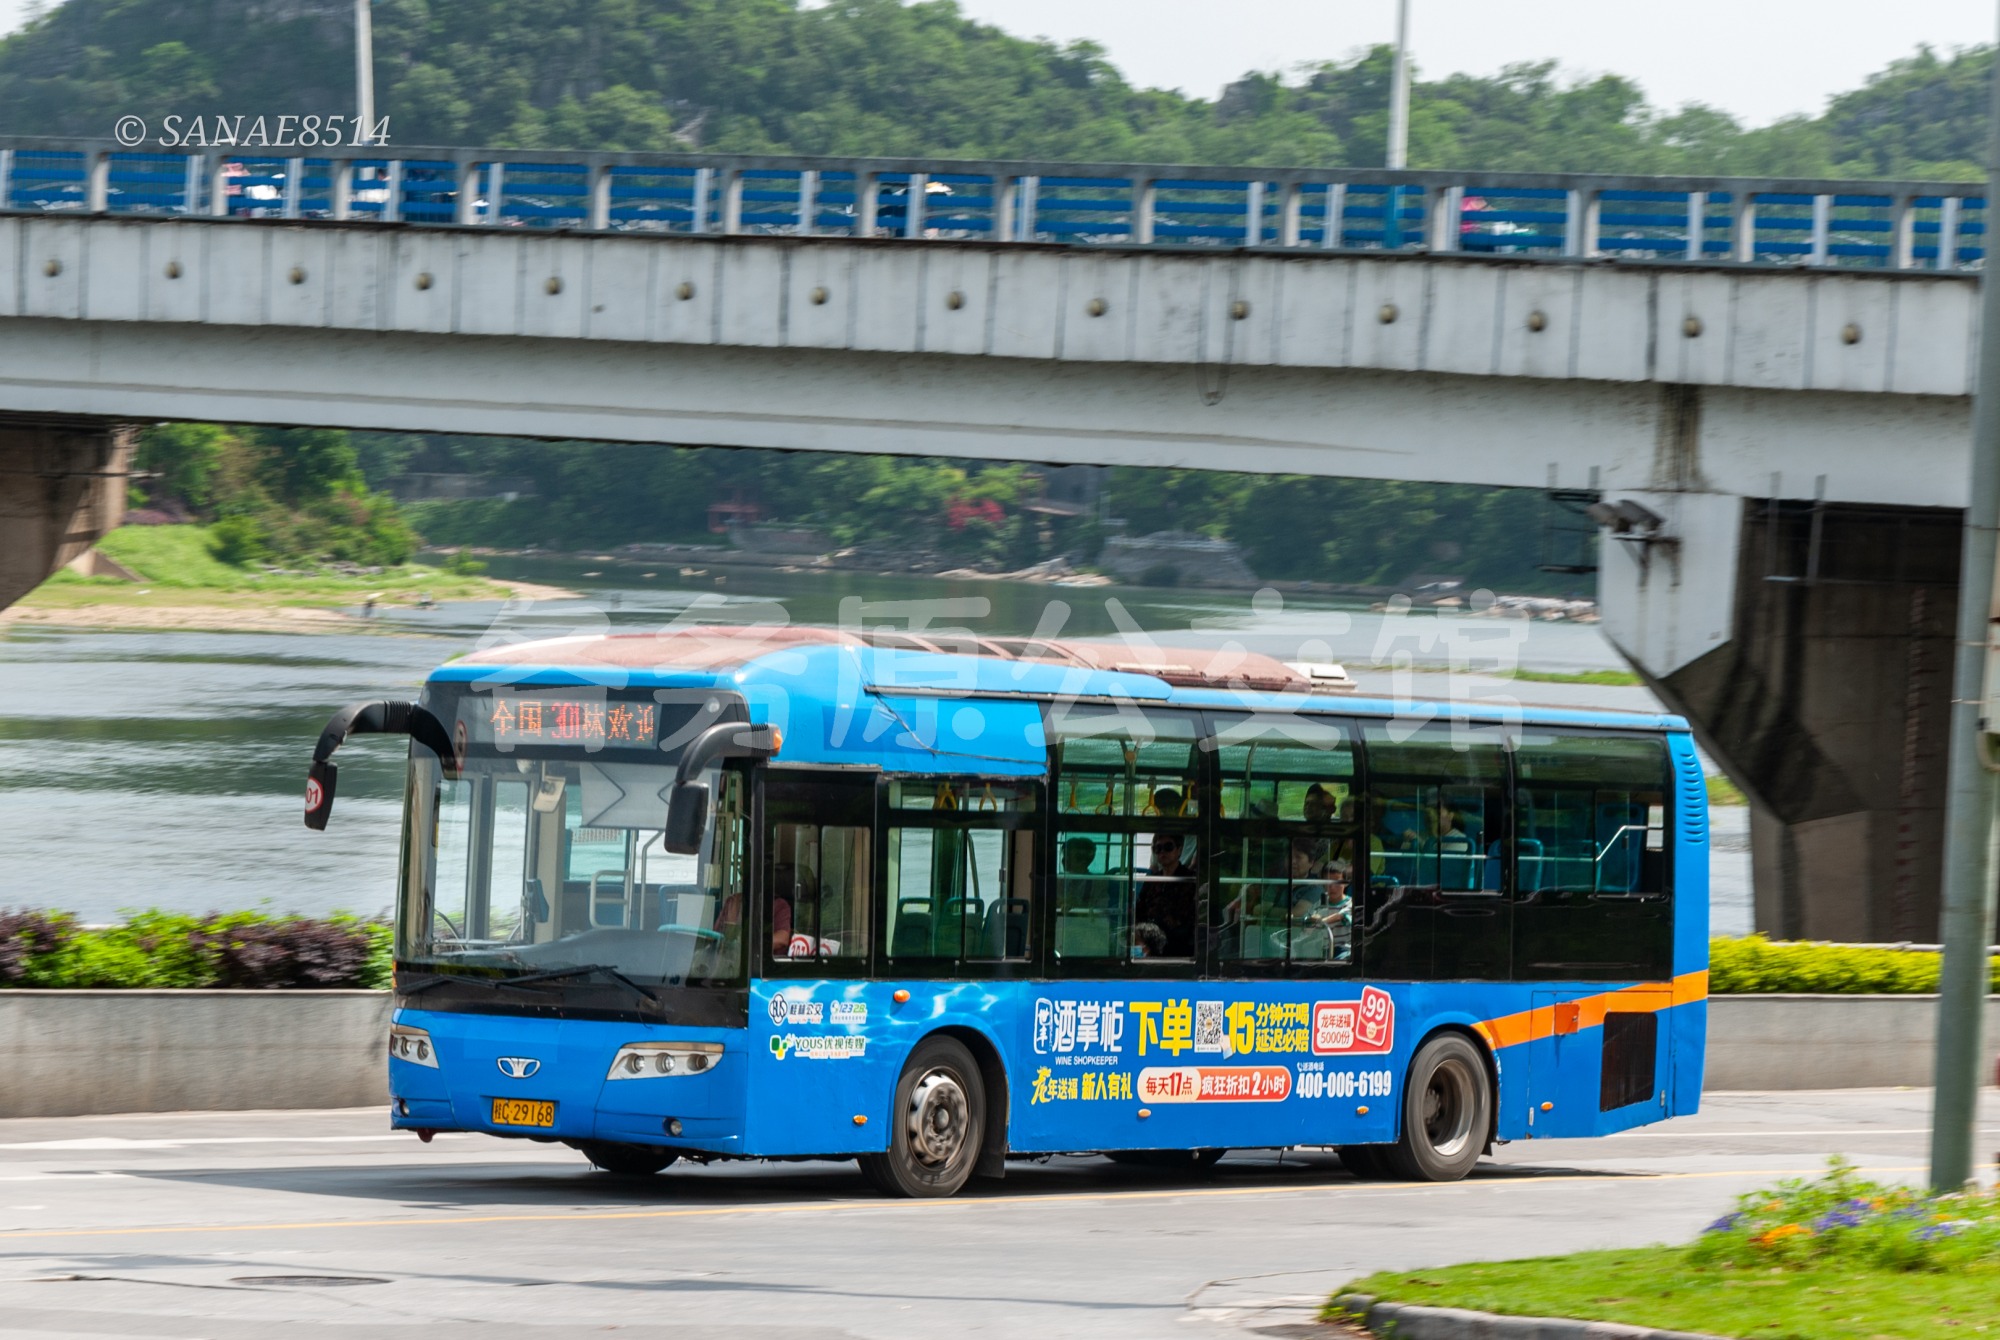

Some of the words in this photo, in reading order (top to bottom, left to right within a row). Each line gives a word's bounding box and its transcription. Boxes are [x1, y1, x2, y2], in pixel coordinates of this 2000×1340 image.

[551, 702, 580, 739] 301
[1052, 1000, 1124, 1053] 酒掌柜
[1129, 999, 1193, 1056] 下单
[1225, 1001, 1255, 1055] 15
[1256, 1002, 1310, 1028] 分钟开喝
[1320, 1014, 1351, 1029] 龙年送福
[1256, 1028, 1310, 1053] 延迟必赔
[1320, 1031, 1350, 1045] 5000份
[1055, 1056, 1072, 1066] WINE
[1073, 1056, 1118, 1066] SHOPKEEPER
[1081, 1072, 1133, 1100] 新人有礼
[1146, 1072, 1194, 1097] 每天17点
[1296, 1070, 1392, 1099] 400-006-6199
